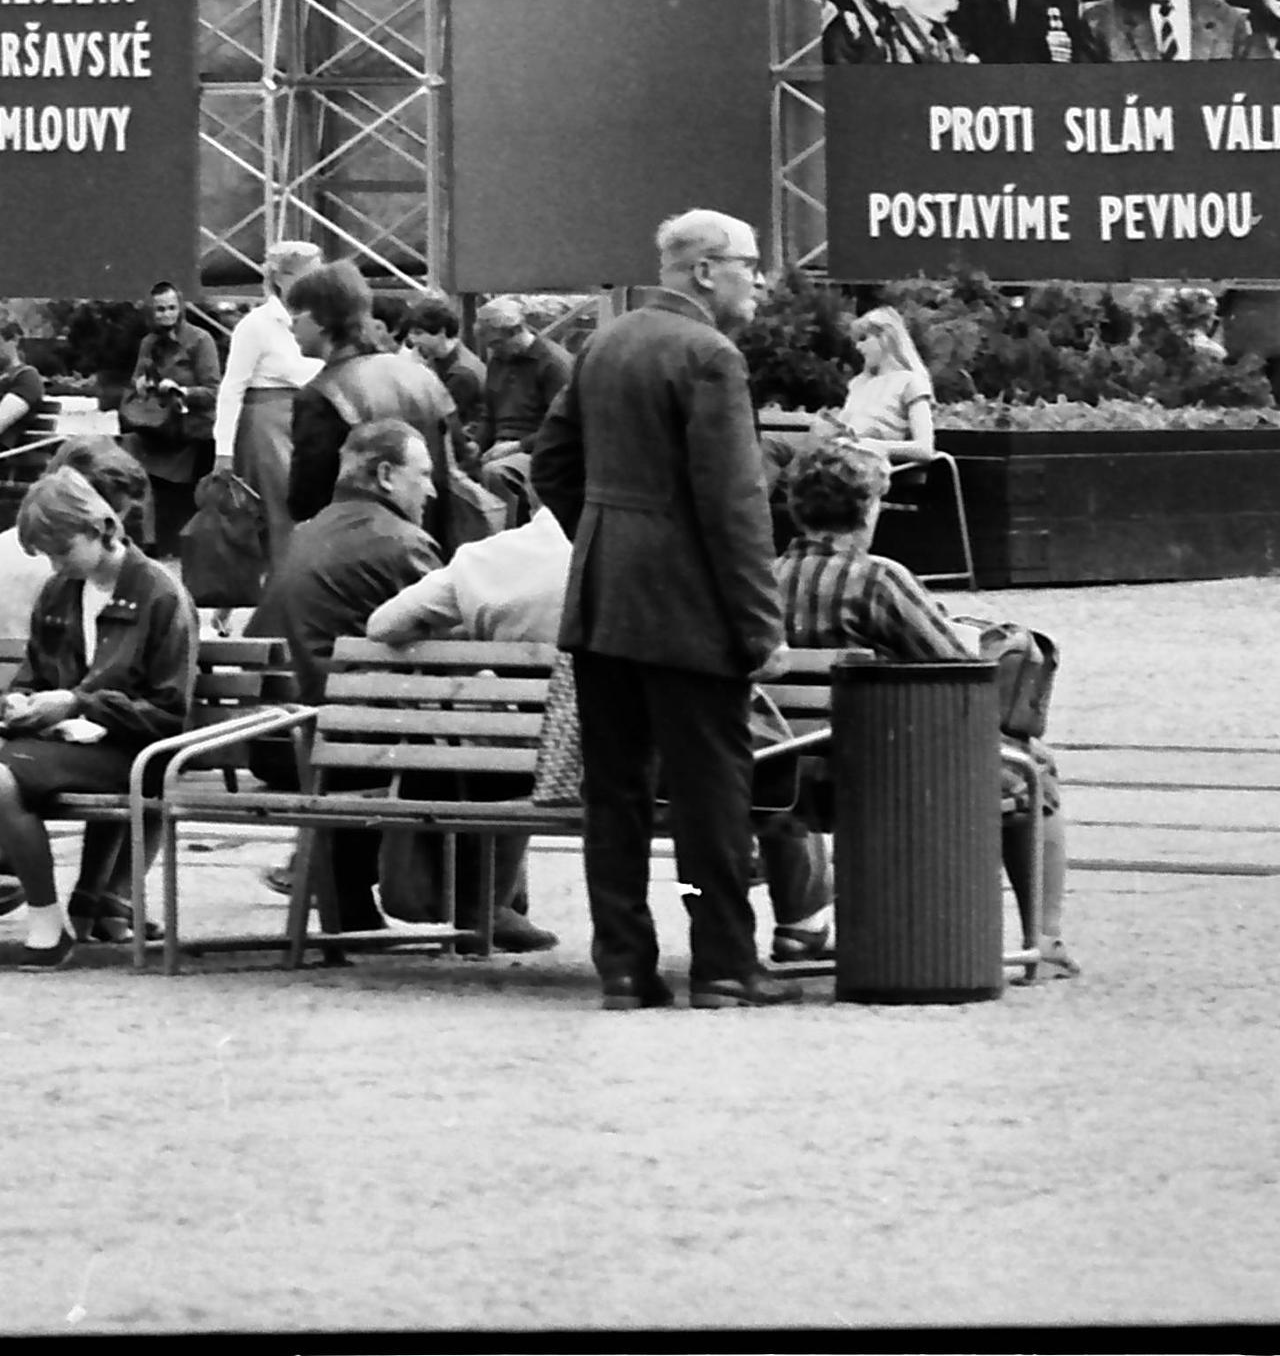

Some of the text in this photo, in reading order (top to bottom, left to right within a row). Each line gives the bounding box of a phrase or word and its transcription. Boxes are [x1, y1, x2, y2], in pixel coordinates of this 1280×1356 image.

[929, 105, 1034, 152] PROTI
[1065, 94, 1174, 153] SILÁM
[869, 183, 1071, 241] POSTAVÍME
[1100, 191, 1253, 241] PEVNOU
